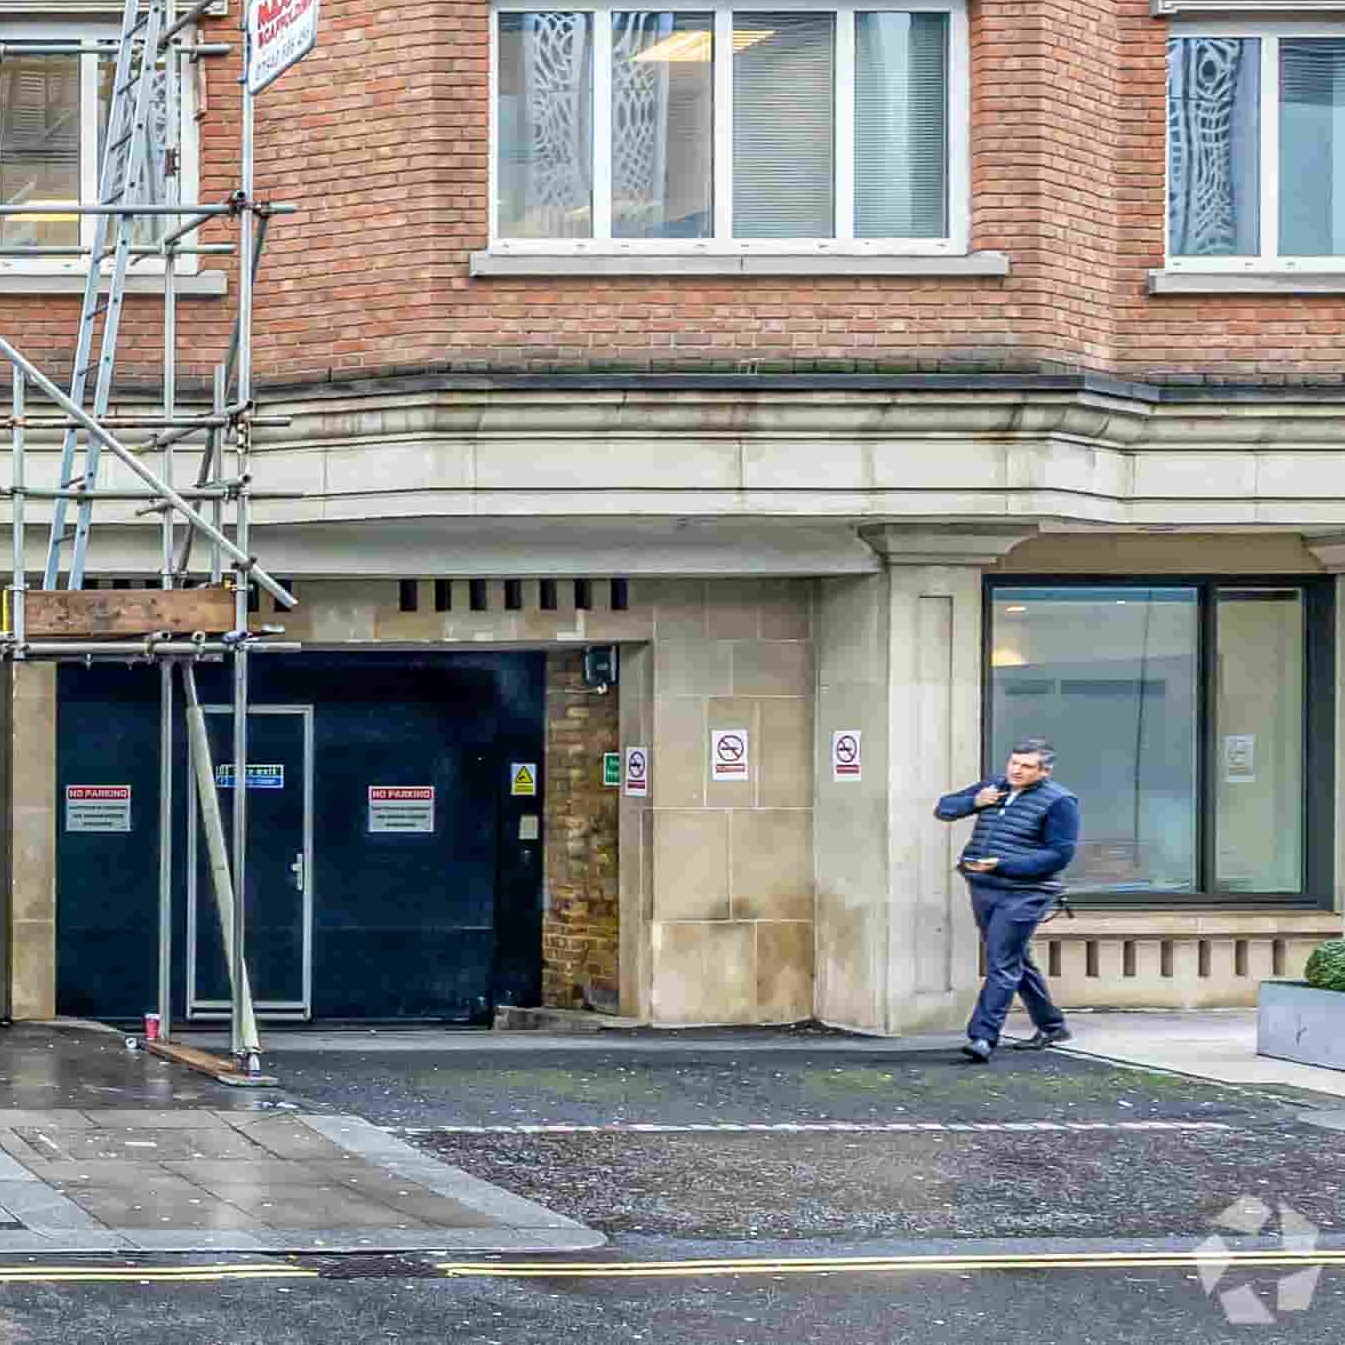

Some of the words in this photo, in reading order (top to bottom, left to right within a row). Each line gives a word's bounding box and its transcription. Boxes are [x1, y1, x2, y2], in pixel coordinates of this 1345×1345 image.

[69, 789, 85, 799] NO
[85, 789, 127, 799] PARKING
[372, 789, 387, 799] NO
[388, 789, 430, 799] PARKING
